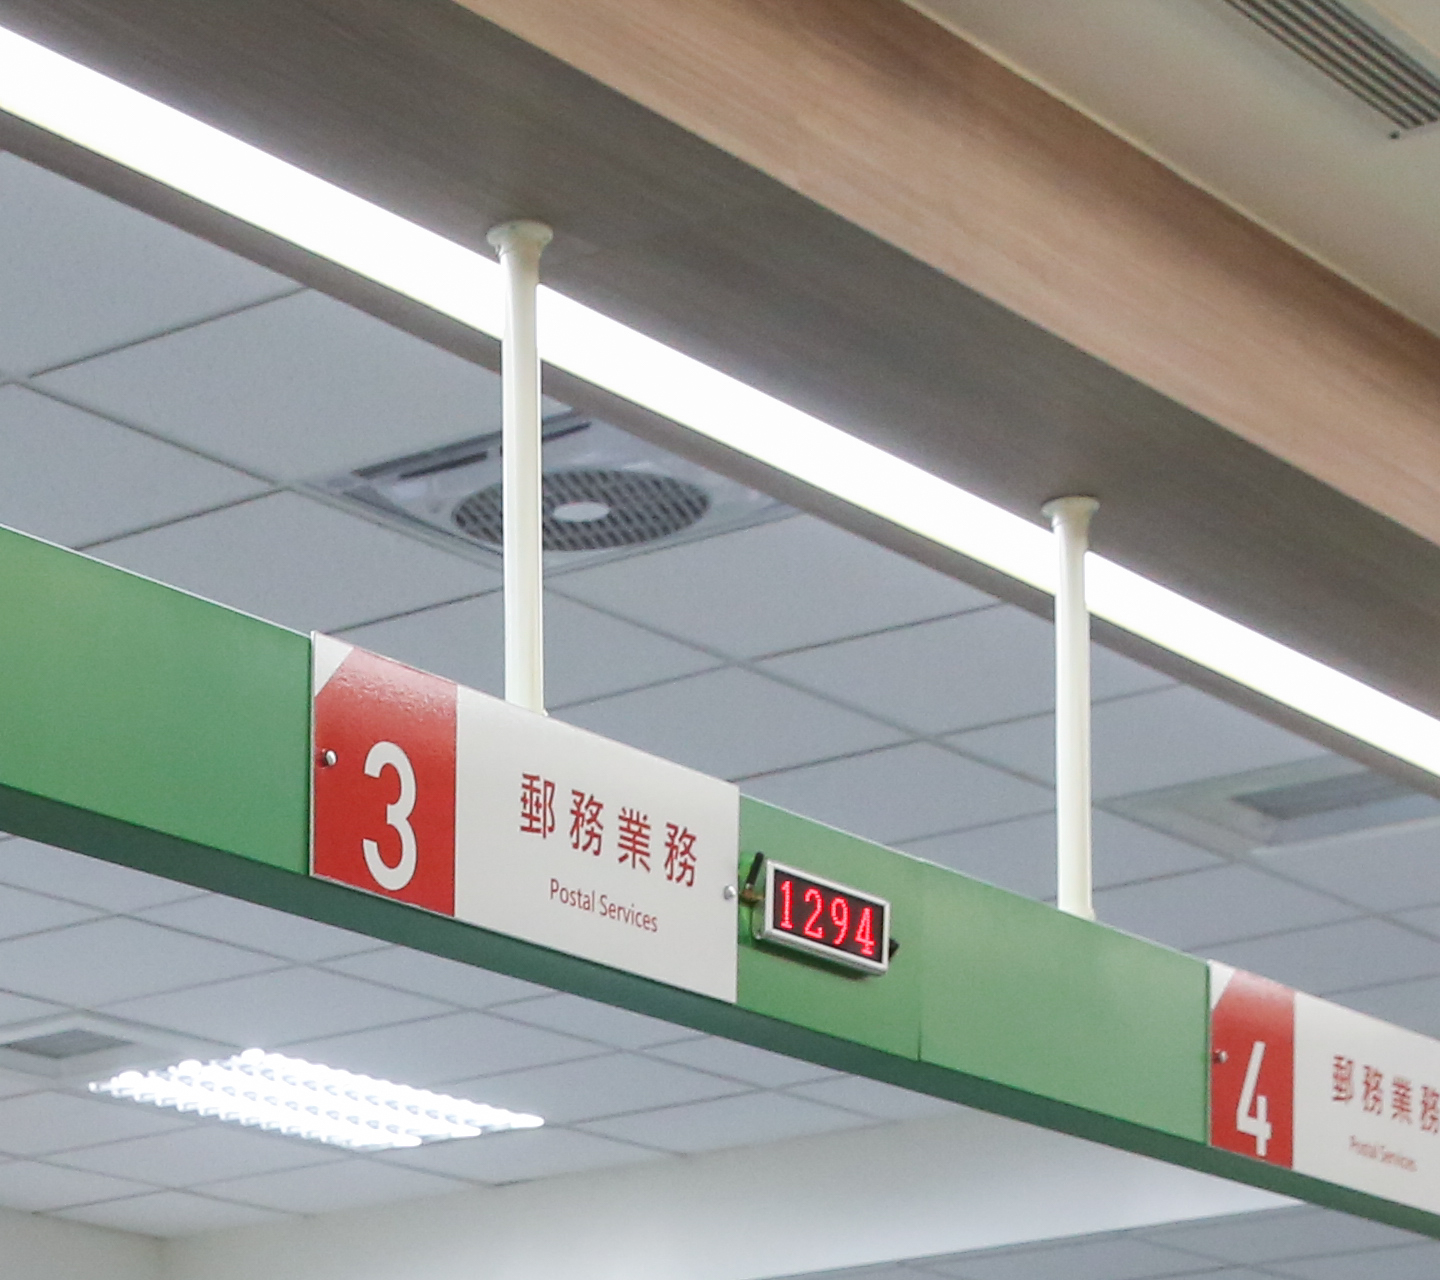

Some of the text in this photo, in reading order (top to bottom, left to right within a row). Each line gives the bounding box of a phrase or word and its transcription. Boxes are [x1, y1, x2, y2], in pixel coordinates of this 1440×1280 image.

[362, 740, 419, 892] 3
[519, 771, 698, 889] 郵務業務
[549, 877, 659, 933] Postal Services
[777, 879, 876, 956] 1294
[1236, 1041, 1272, 1157] 4
